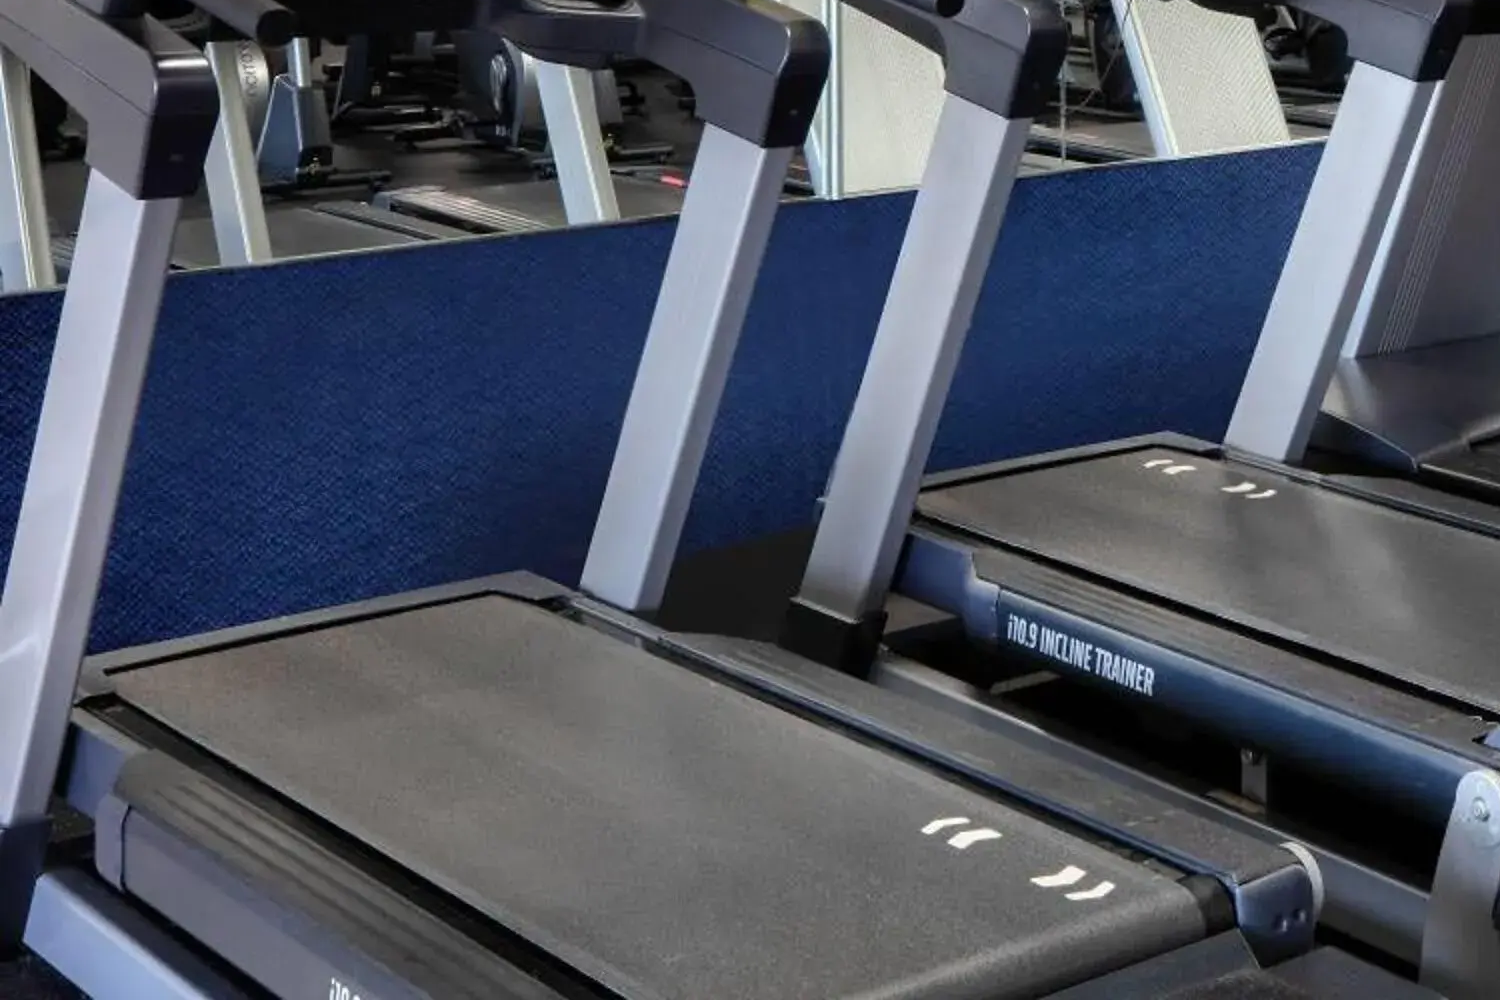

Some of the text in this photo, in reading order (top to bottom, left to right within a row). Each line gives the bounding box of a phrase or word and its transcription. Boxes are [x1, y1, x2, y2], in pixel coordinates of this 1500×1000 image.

[1007, 613, 1156, 697] i10.9 INCLINE TRAINER
